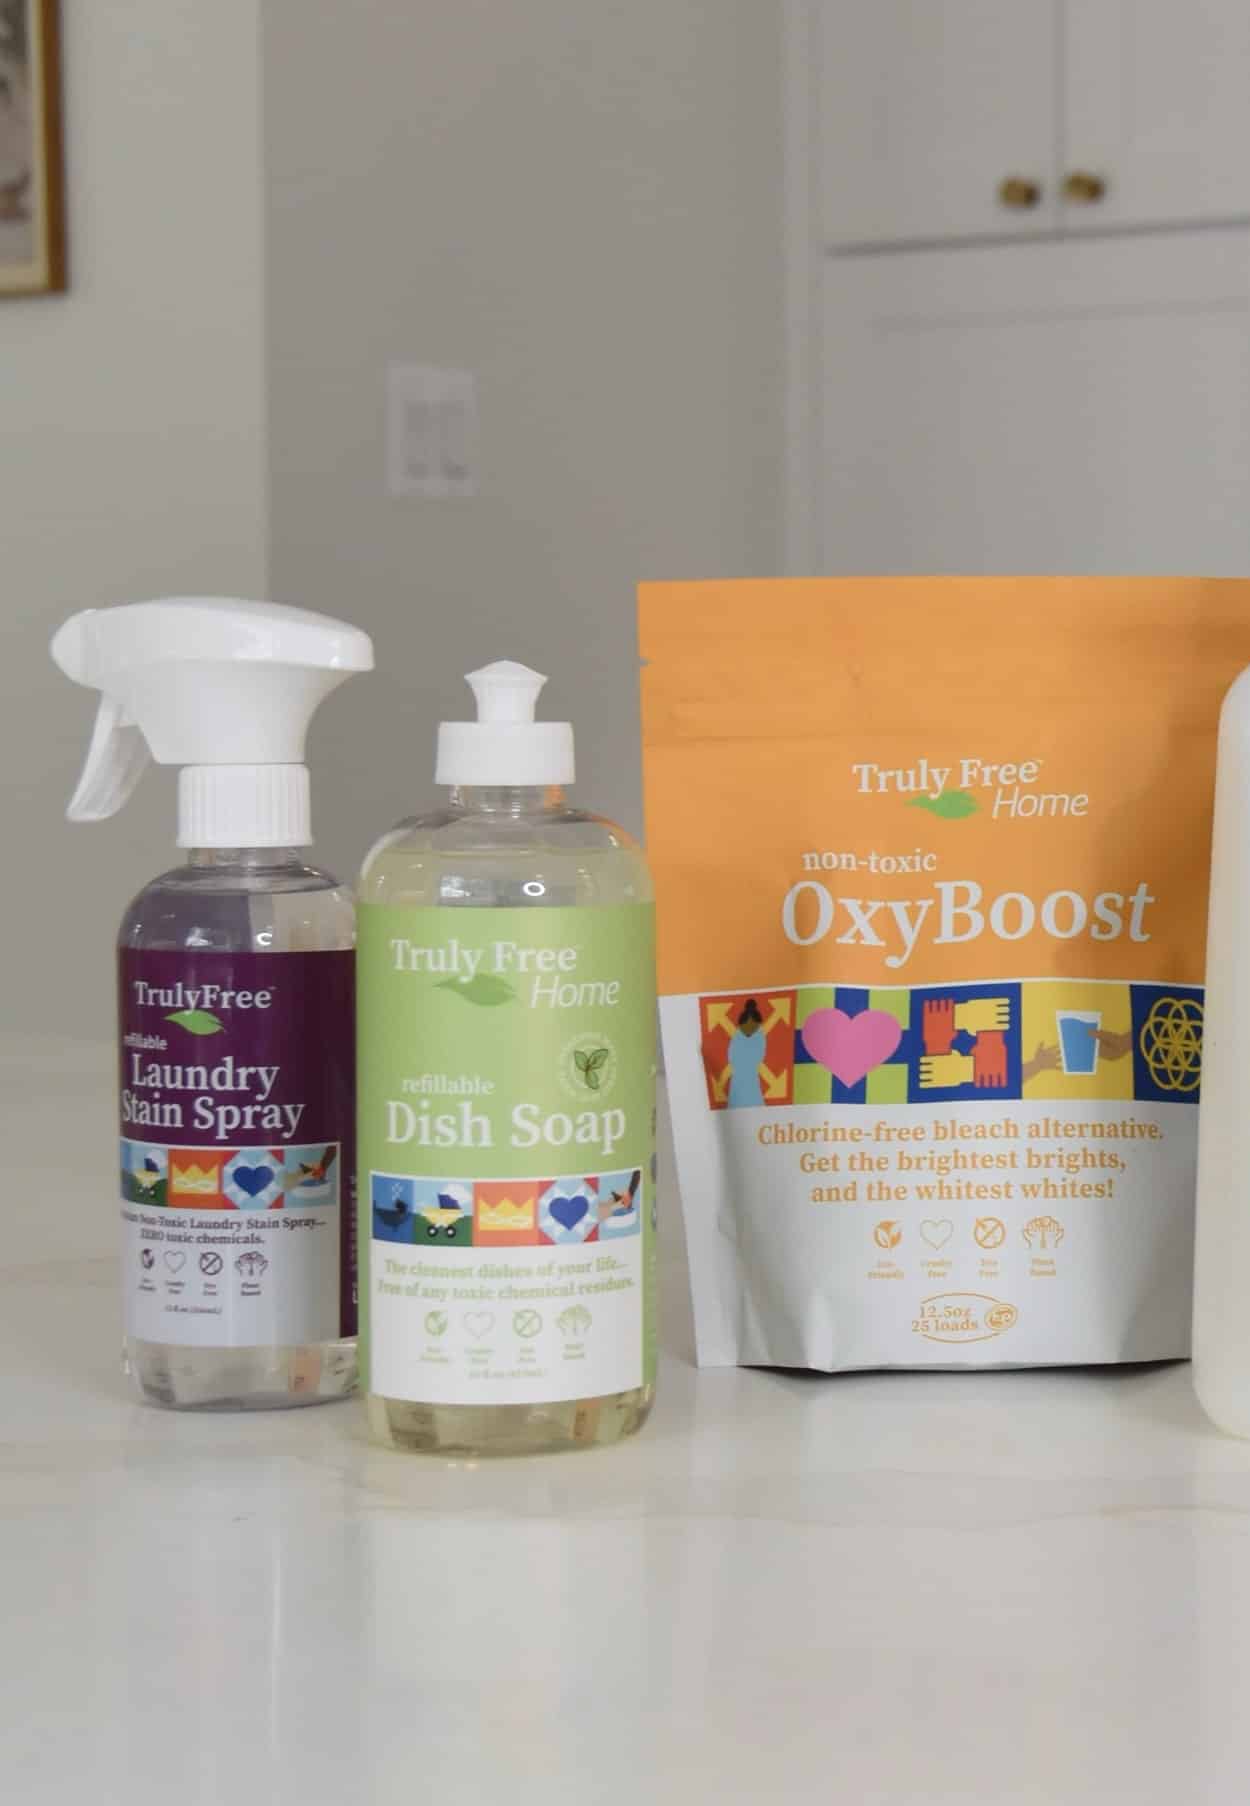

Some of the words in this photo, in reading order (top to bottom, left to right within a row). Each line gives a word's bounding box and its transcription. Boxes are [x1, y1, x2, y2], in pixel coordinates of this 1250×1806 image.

[853, 759, 952, 800] Truly
[960, 757, 1040, 788] Free
[992, 788, 1089, 819] Home
[802, 848, 938, 873] non-toxic
[781, 879, 1156, 969] OxyBoost
[391, 938, 485, 984] Truly
[492, 941, 578, 974] Free
[134, 980, 273, 1015] TrulyFree
[530, 975, 621, 1009] Home
[131, 1053, 281, 1101] Laundry
[401, 1073, 496, 1096] refillable
[122, 1089, 185, 1128] Stain
[192, 1095, 307, 1141] Spray
[386, 1100, 495, 1148] Dish
[510, 1103, 626, 1156] Soap
[757, 1121, 927, 1145] Chlorine-free
[934, 1118, 1020, 1141] bleach
[1028, 1118, 1165, 1141] alternative.
[799, 1151, 841, 1174] Get
[848, 1151, 889, 1173] the
[897, 1148, 1019, 1176] brightest
[1026, 1147, 1127, 1174] brights,
[812, 1180, 858, 1204] and
[866, 1180, 907, 1202] the
[914, 1179, 1015, 1200] whitest
[1020, 1177, 1115, 1200] whites!
[190, 1215, 244, 1232] Laundry
[246, 1213, 280, 1229] Stain
[196, 1231, 265, 1245] chemicals.
[421, 1286, 447, 1303] any
[452, 1283, 495, 1300] toxic
[499, 1282, 576, 1300] chemical
[911, 1320, 930, 1333] 25
[935, 1318, 979, 1332] loads
